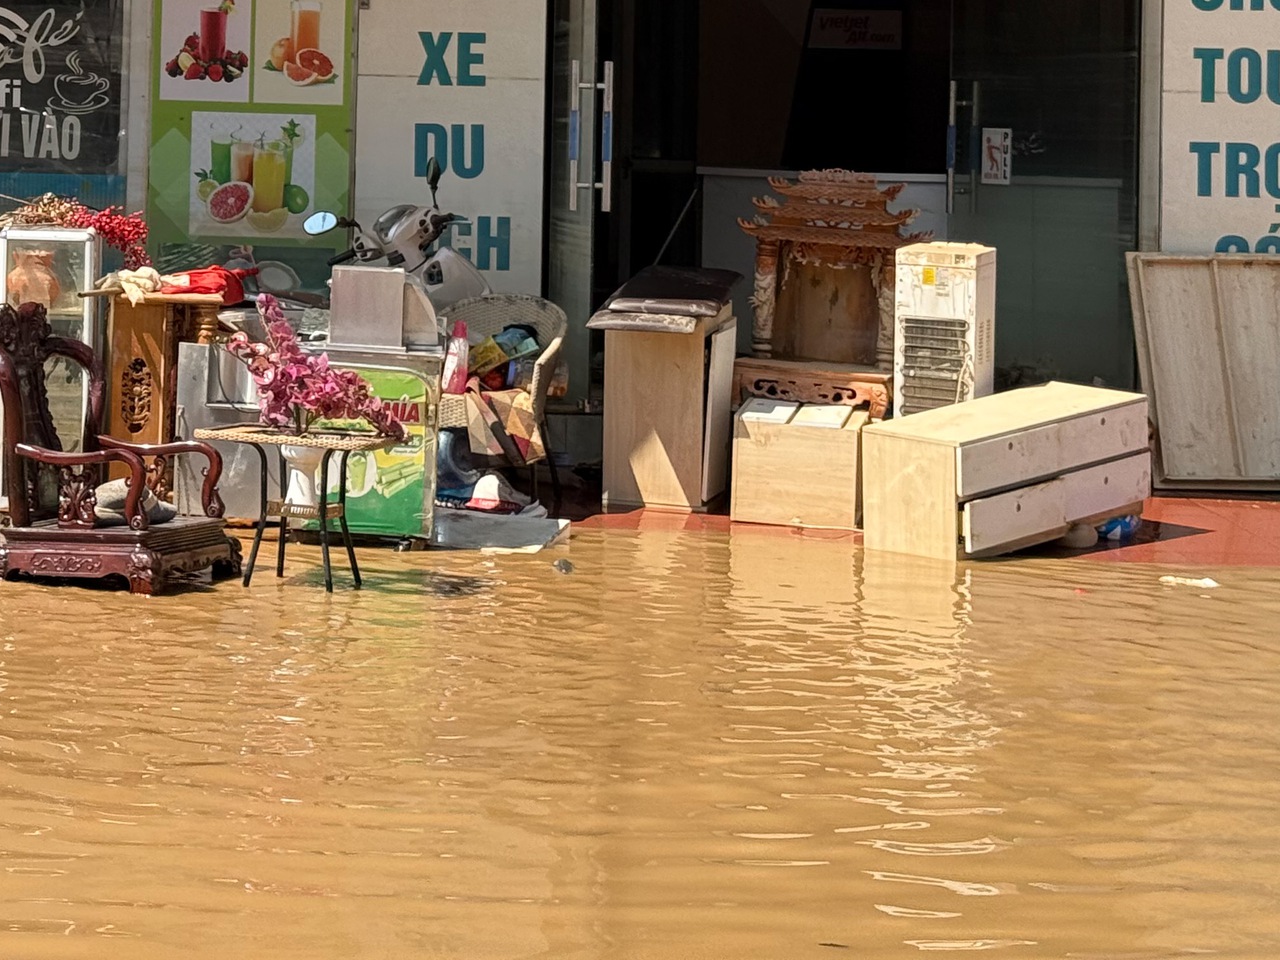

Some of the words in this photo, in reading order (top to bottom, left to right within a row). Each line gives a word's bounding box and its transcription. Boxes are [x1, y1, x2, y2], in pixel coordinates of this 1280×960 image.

[416, 30, 487, 87] XE
[21, 107, 82, 161] VÀO
[413, 122, 485, 179] DU
